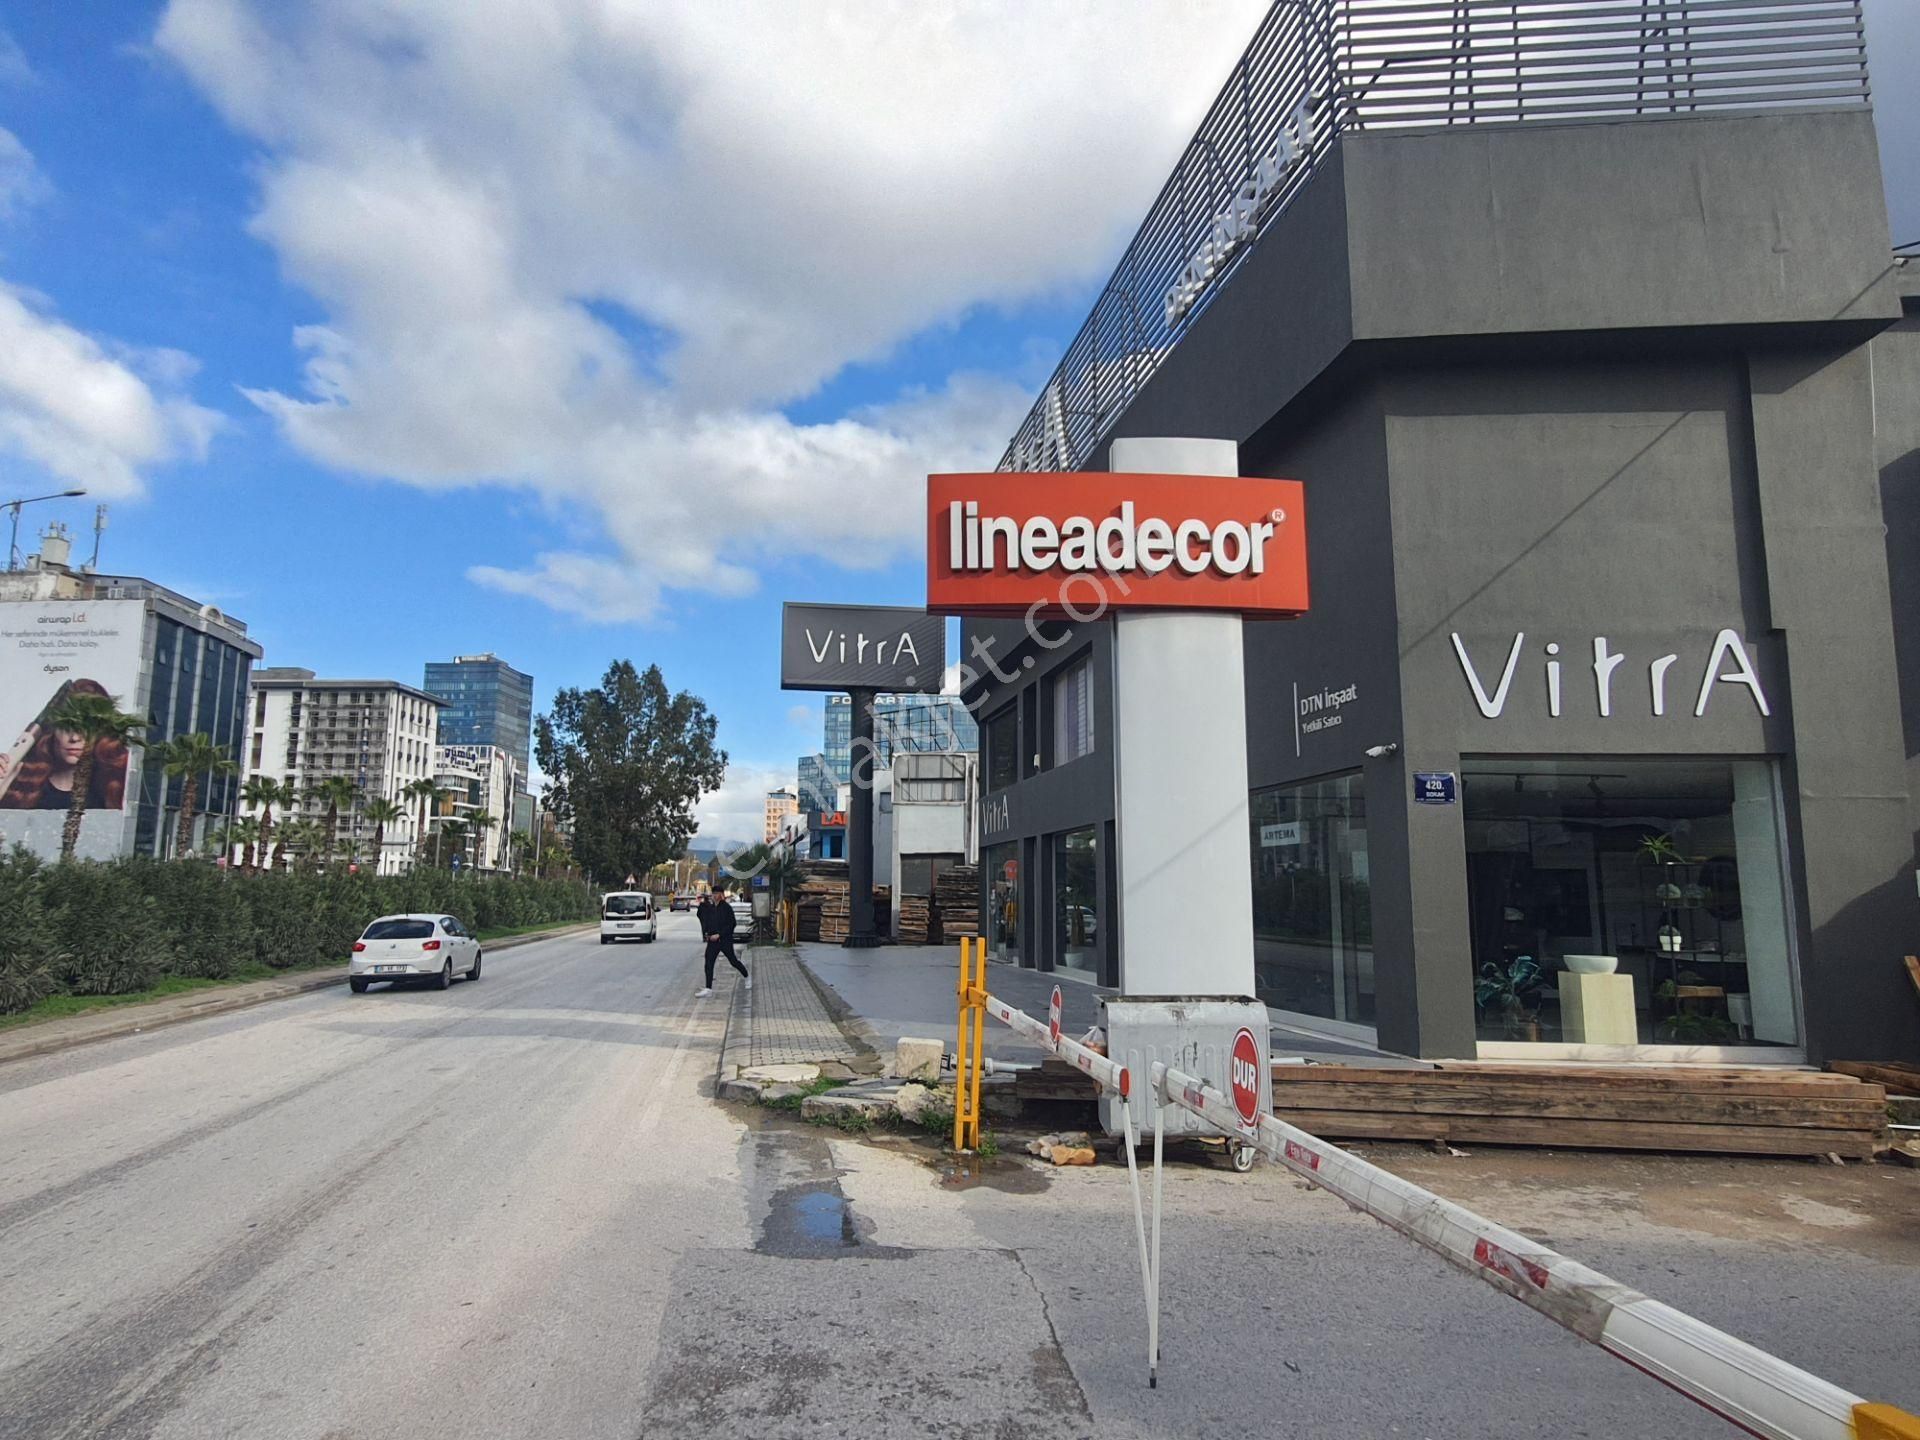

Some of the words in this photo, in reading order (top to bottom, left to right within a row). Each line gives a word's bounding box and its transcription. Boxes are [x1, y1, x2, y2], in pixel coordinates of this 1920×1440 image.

[949, 500, 1274, 575] lineadecor
[37, 615, 72, 624] airwrap
[806, 629, 920, 666] VitrA
[43, 664, 70, 674] dyson
[1451, 629, 1770, 718] VitrA
[1301, 693, 1323, 715] DTN
[1325, 684, 1357, 709] İnşaat
[982, 794, 1009, 835] VitrA
[1264, 829, 1296, 840] ARTEMA
[1233, 1056, 1257, 1094] DUR
